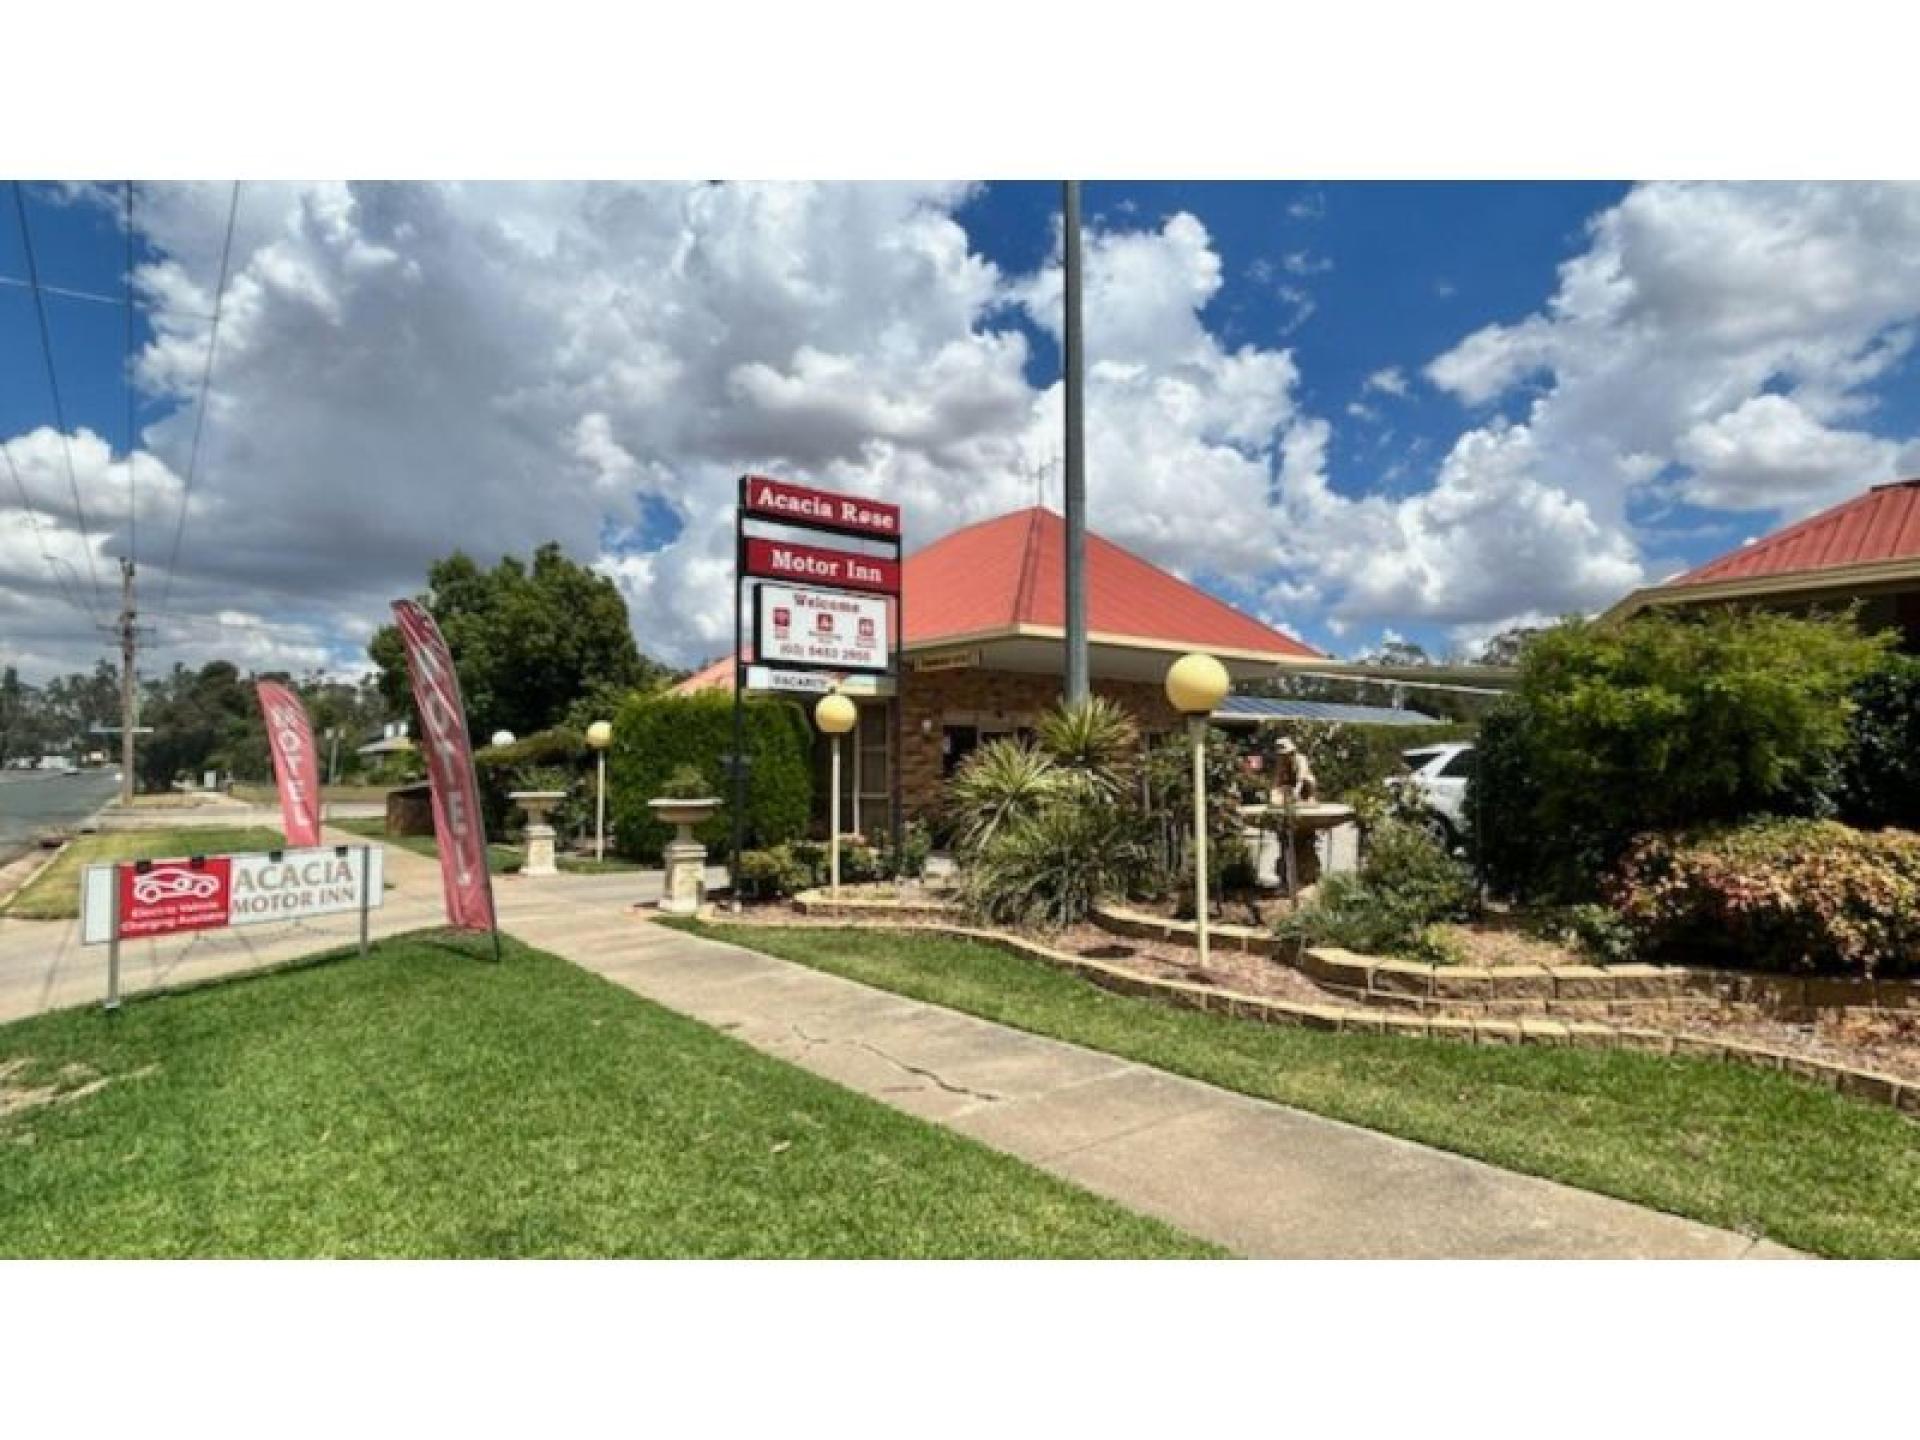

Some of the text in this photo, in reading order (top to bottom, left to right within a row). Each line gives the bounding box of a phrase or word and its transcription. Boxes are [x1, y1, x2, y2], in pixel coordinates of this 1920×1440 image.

[757, 486, 894, 529] Acacia Rose
[771, 549, 882, 582] Motor Inn
[794, 593, 860, 612] Welcome
[233, 861, 354, 893] ACACIA
[232, 886, 355, 913] MOTOR INN
